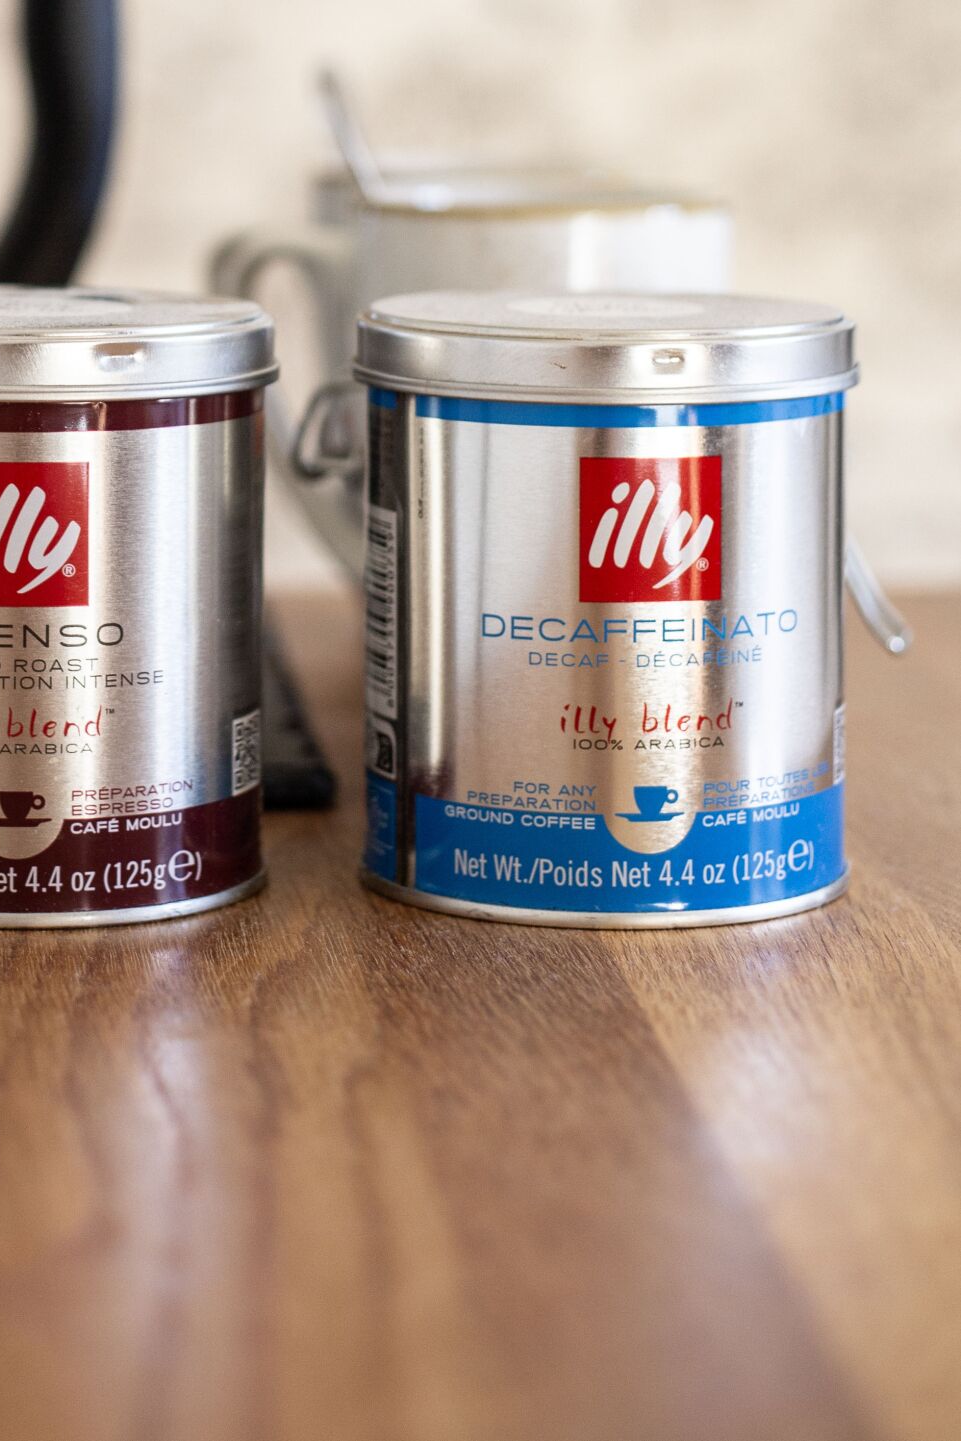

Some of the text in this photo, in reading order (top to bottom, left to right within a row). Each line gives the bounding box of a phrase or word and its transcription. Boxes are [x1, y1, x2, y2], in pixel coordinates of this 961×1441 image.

[588, 478, 715, 589] illy
[481, 610, 798, 643] DECAFFEINATO
[14, 658, 99, 672] ROAST
[528, 652, 609, 667] DECAF
[65, 670, 164, 689] INTENSE
[7, 705, 102, 738] blend
[560, 698, 732, 740] illy blend
[0, 742, 93, 754] ARABICA
[573, 736, 725, 751] 100% ARABICA
[71, 778, 194, 802] PRÉPARATION
[513, 781, 597, 797] FOR ANY
[703, 779, 750, 794] POUR
[757, 768, 809, 788] TOUTES
[71, 797, 174, 816] ESPRESSO
[467, 790, 596, 811] PREPARATION
[70, 812, 183, 835] CAFÉ MOULU
[444, 805, 596, 831] GROUND COFFEE
[702, 803, 800, 828] CAFÉ MOULU
[25, 865, 63, 894] 4.4
[71, 871, 96, 893] oz
[454, 848, 487, 880] Net
[493, 854, 603, 888] Wt./Poids
[611, 861, 652, 888] Net
[658, 859, 695, 887] 4.4
[702, 863, 726, 885] oz
